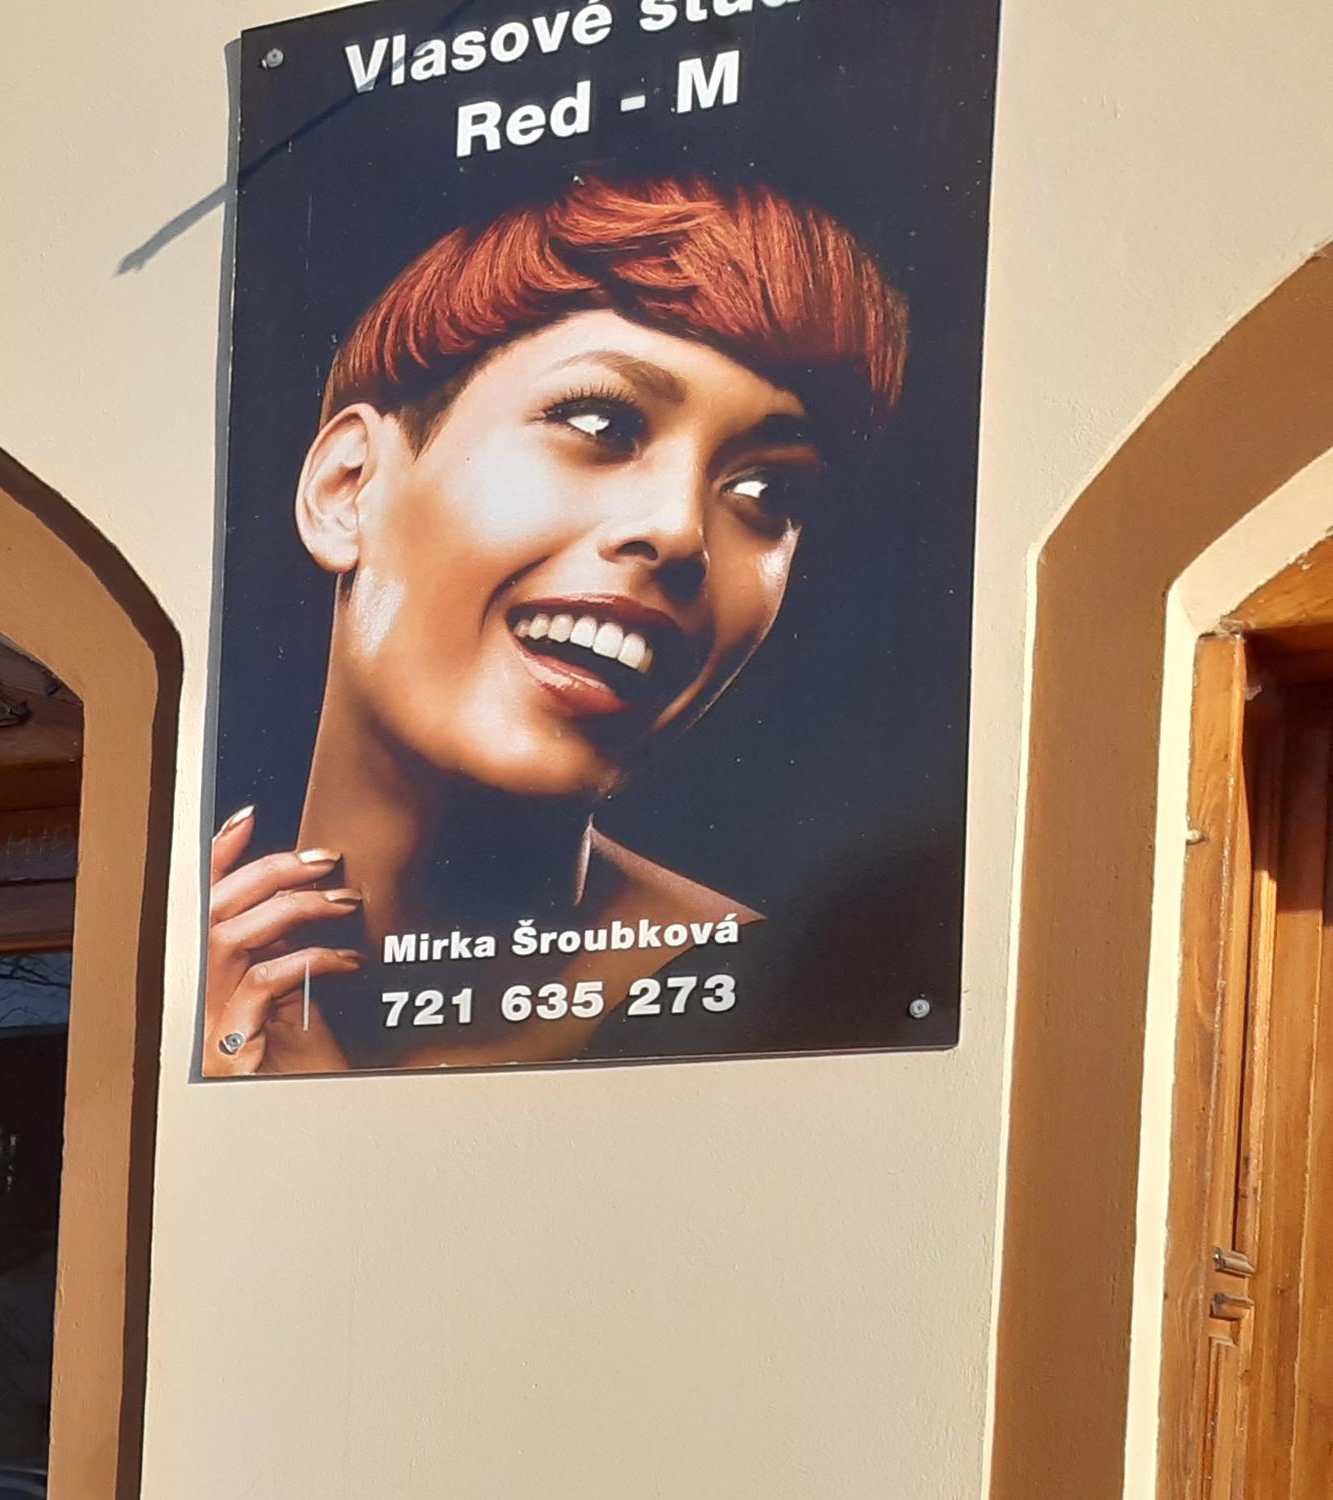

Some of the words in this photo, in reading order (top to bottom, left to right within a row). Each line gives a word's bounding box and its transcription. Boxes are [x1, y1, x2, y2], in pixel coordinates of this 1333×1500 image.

[345, 0, 613, 93] Vlasové
[456, 80, 591, 158] Red
[677, 49, 739, 114] M
[383, 931, 496, 963] Mirka
[512, 913, 738, 956] Šroubková
[382, 989, 472, 1027] 721
[501, 981, 604, 1021] 635
[628, 975, 736, 1016] 273
